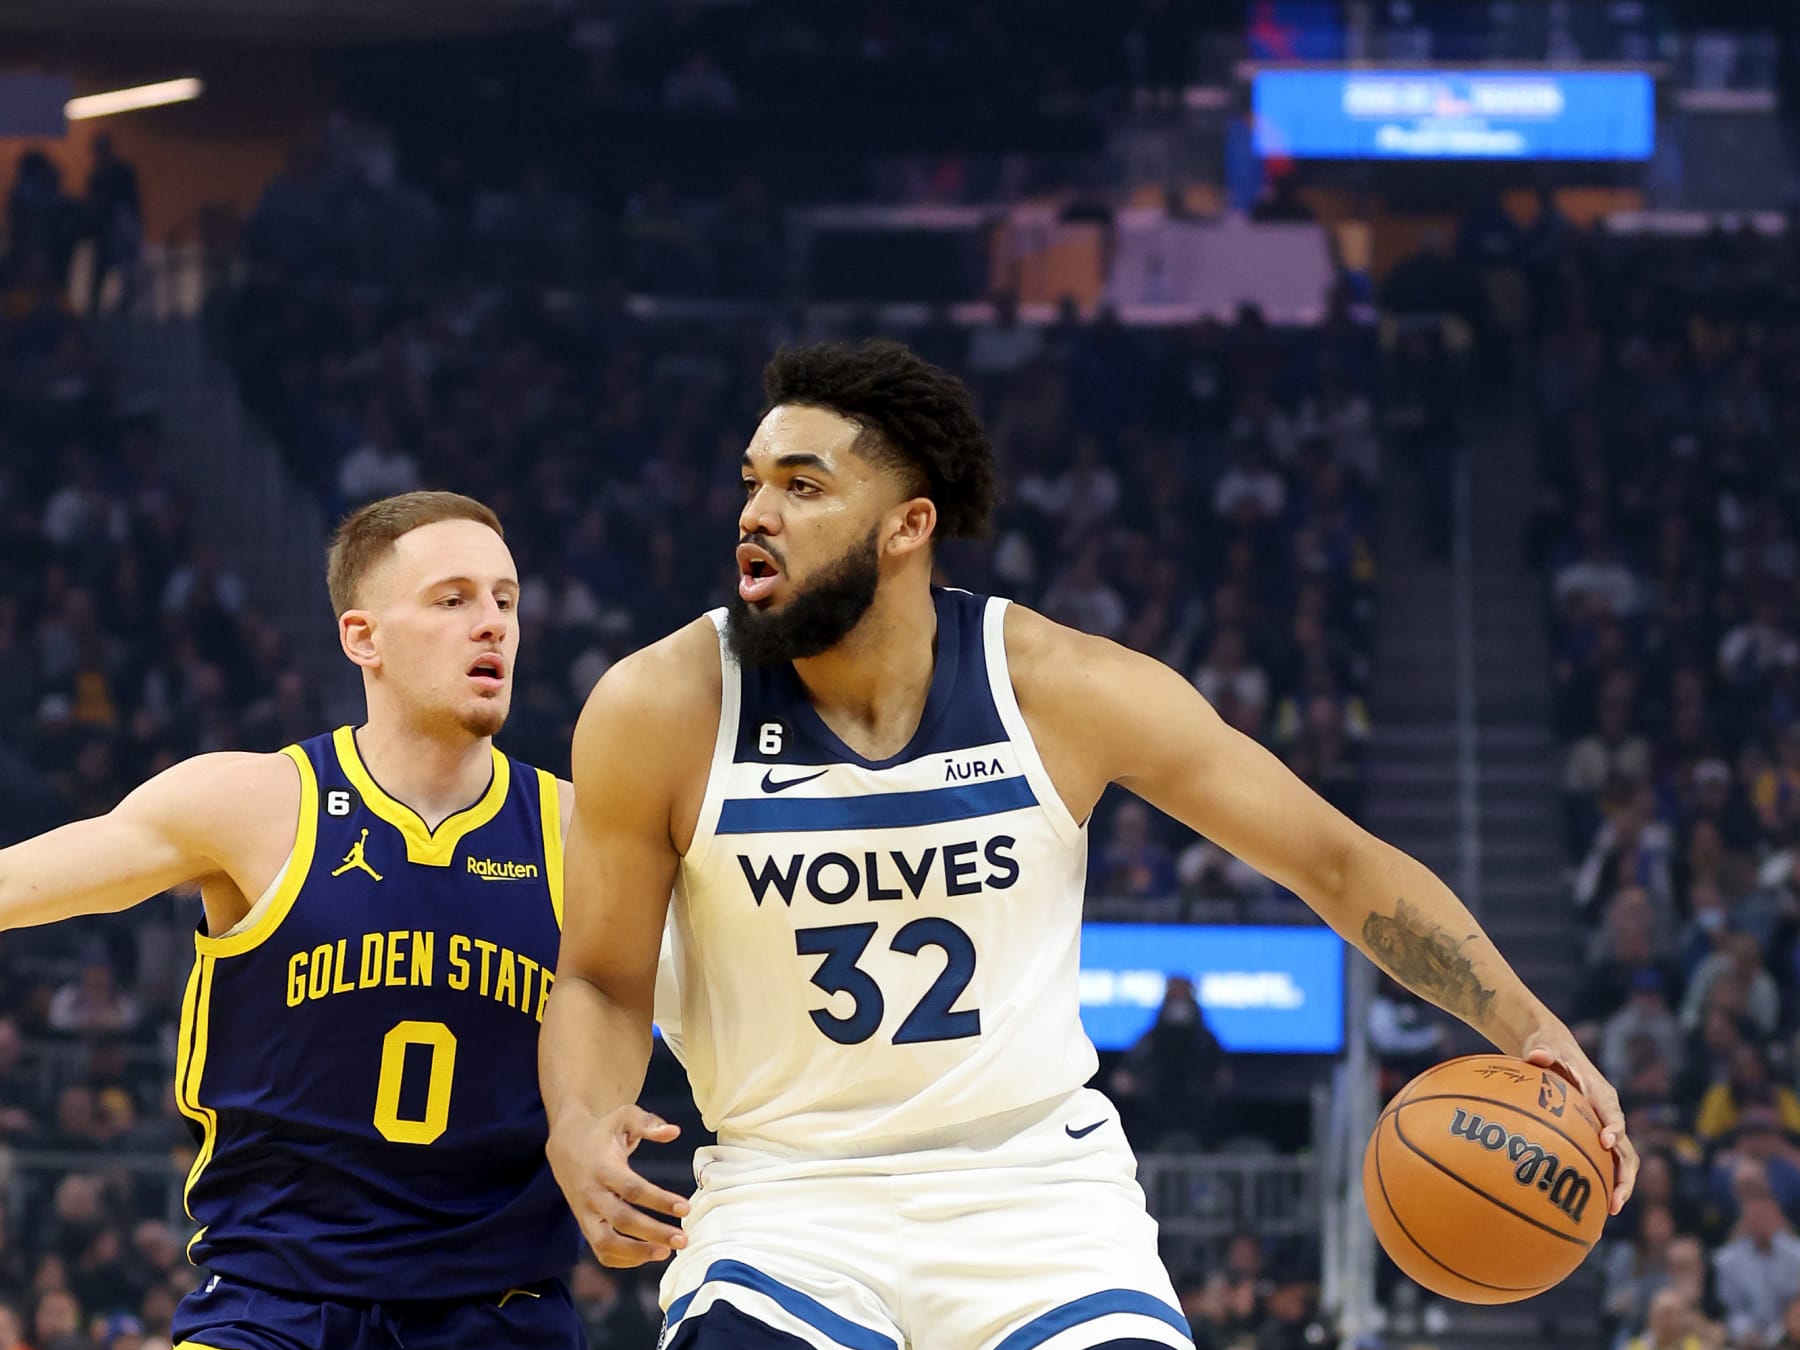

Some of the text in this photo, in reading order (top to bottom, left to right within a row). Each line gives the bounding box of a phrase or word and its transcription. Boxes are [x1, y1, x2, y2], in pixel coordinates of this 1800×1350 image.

[759, 722, 783, 755] 6
[327, 791, 350, 816] 6
[467, 856, 538, 878] Rakuten
[737, 835, 1020, 907] WOLVES
[286, 931, 434, 1008] GOLDEN
[795, 917, 981, 1045] 32
[373, 1020, 457, 1145] 0
[1449, 1106, 1592, 1226] Wilson
